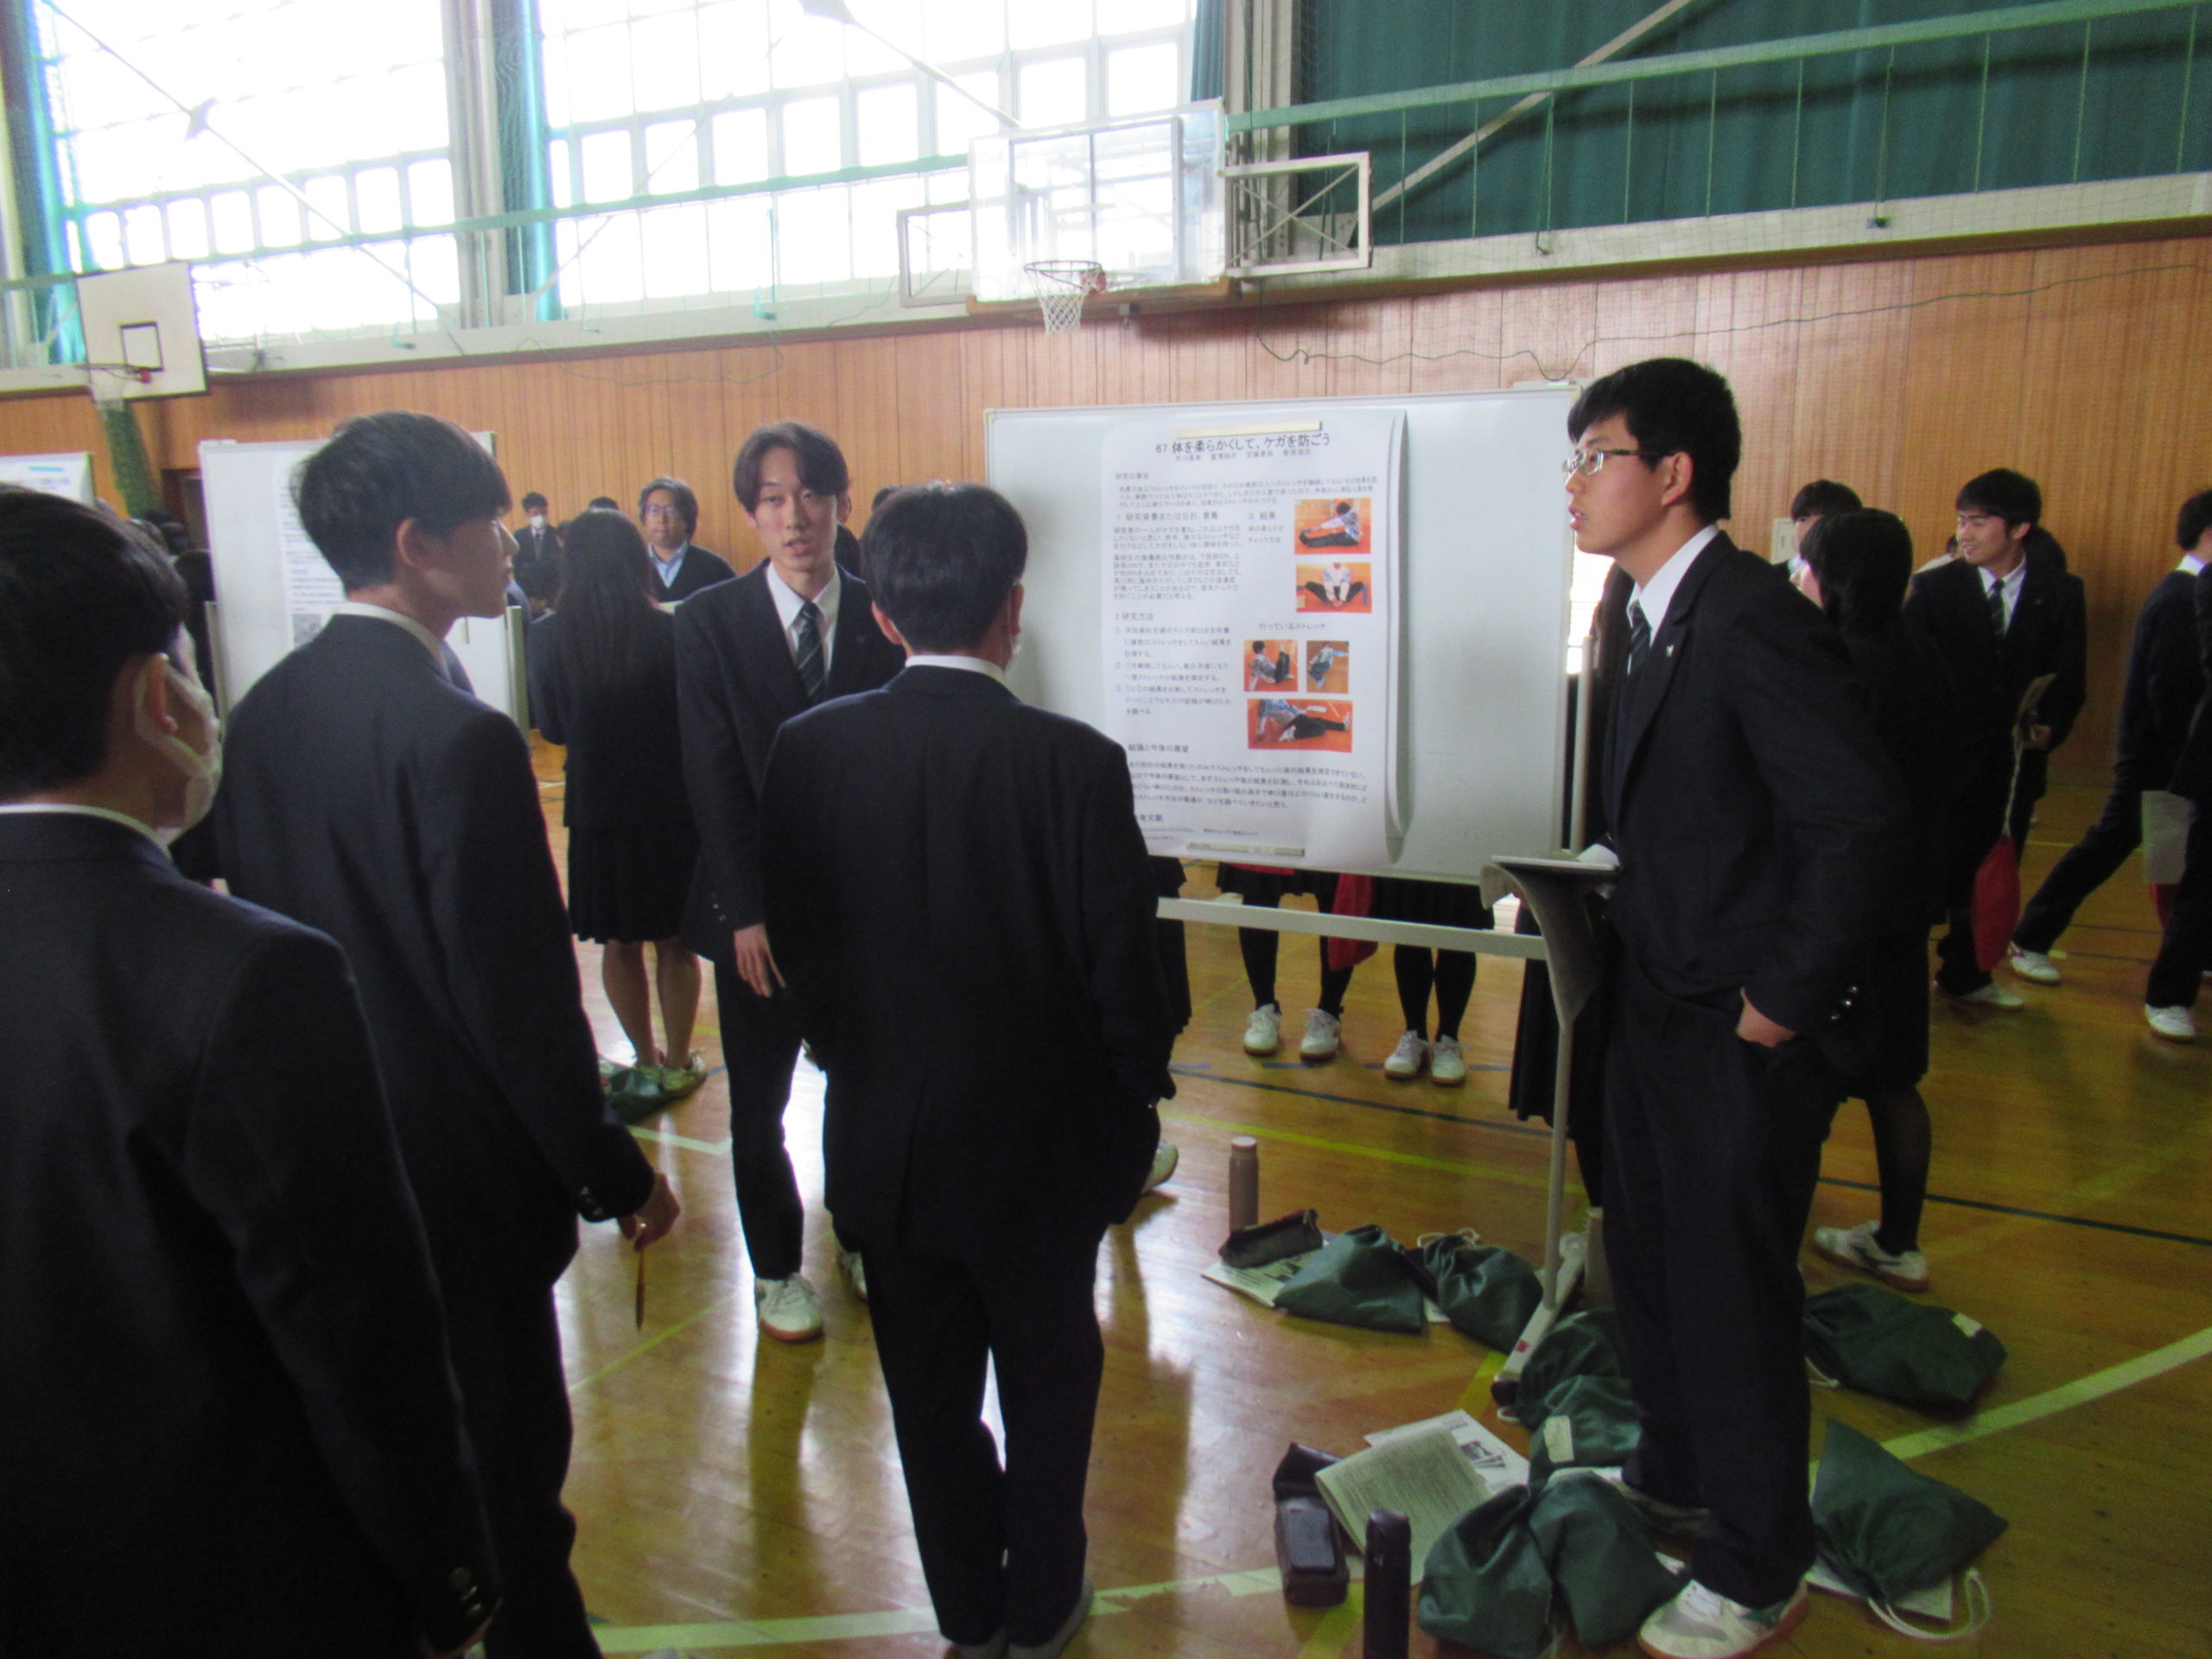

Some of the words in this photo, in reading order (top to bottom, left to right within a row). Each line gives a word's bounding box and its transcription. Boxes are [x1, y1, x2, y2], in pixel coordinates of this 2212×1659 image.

[1172, 432, 1331, 454] 体を柔らかくして、ケガを防ごう
[1122, 612, 1154, 621] 研究方法
[1260, 621, 1325, 631] 行っているストレッチ
[1136, 814, 1164, 823] 考文献
